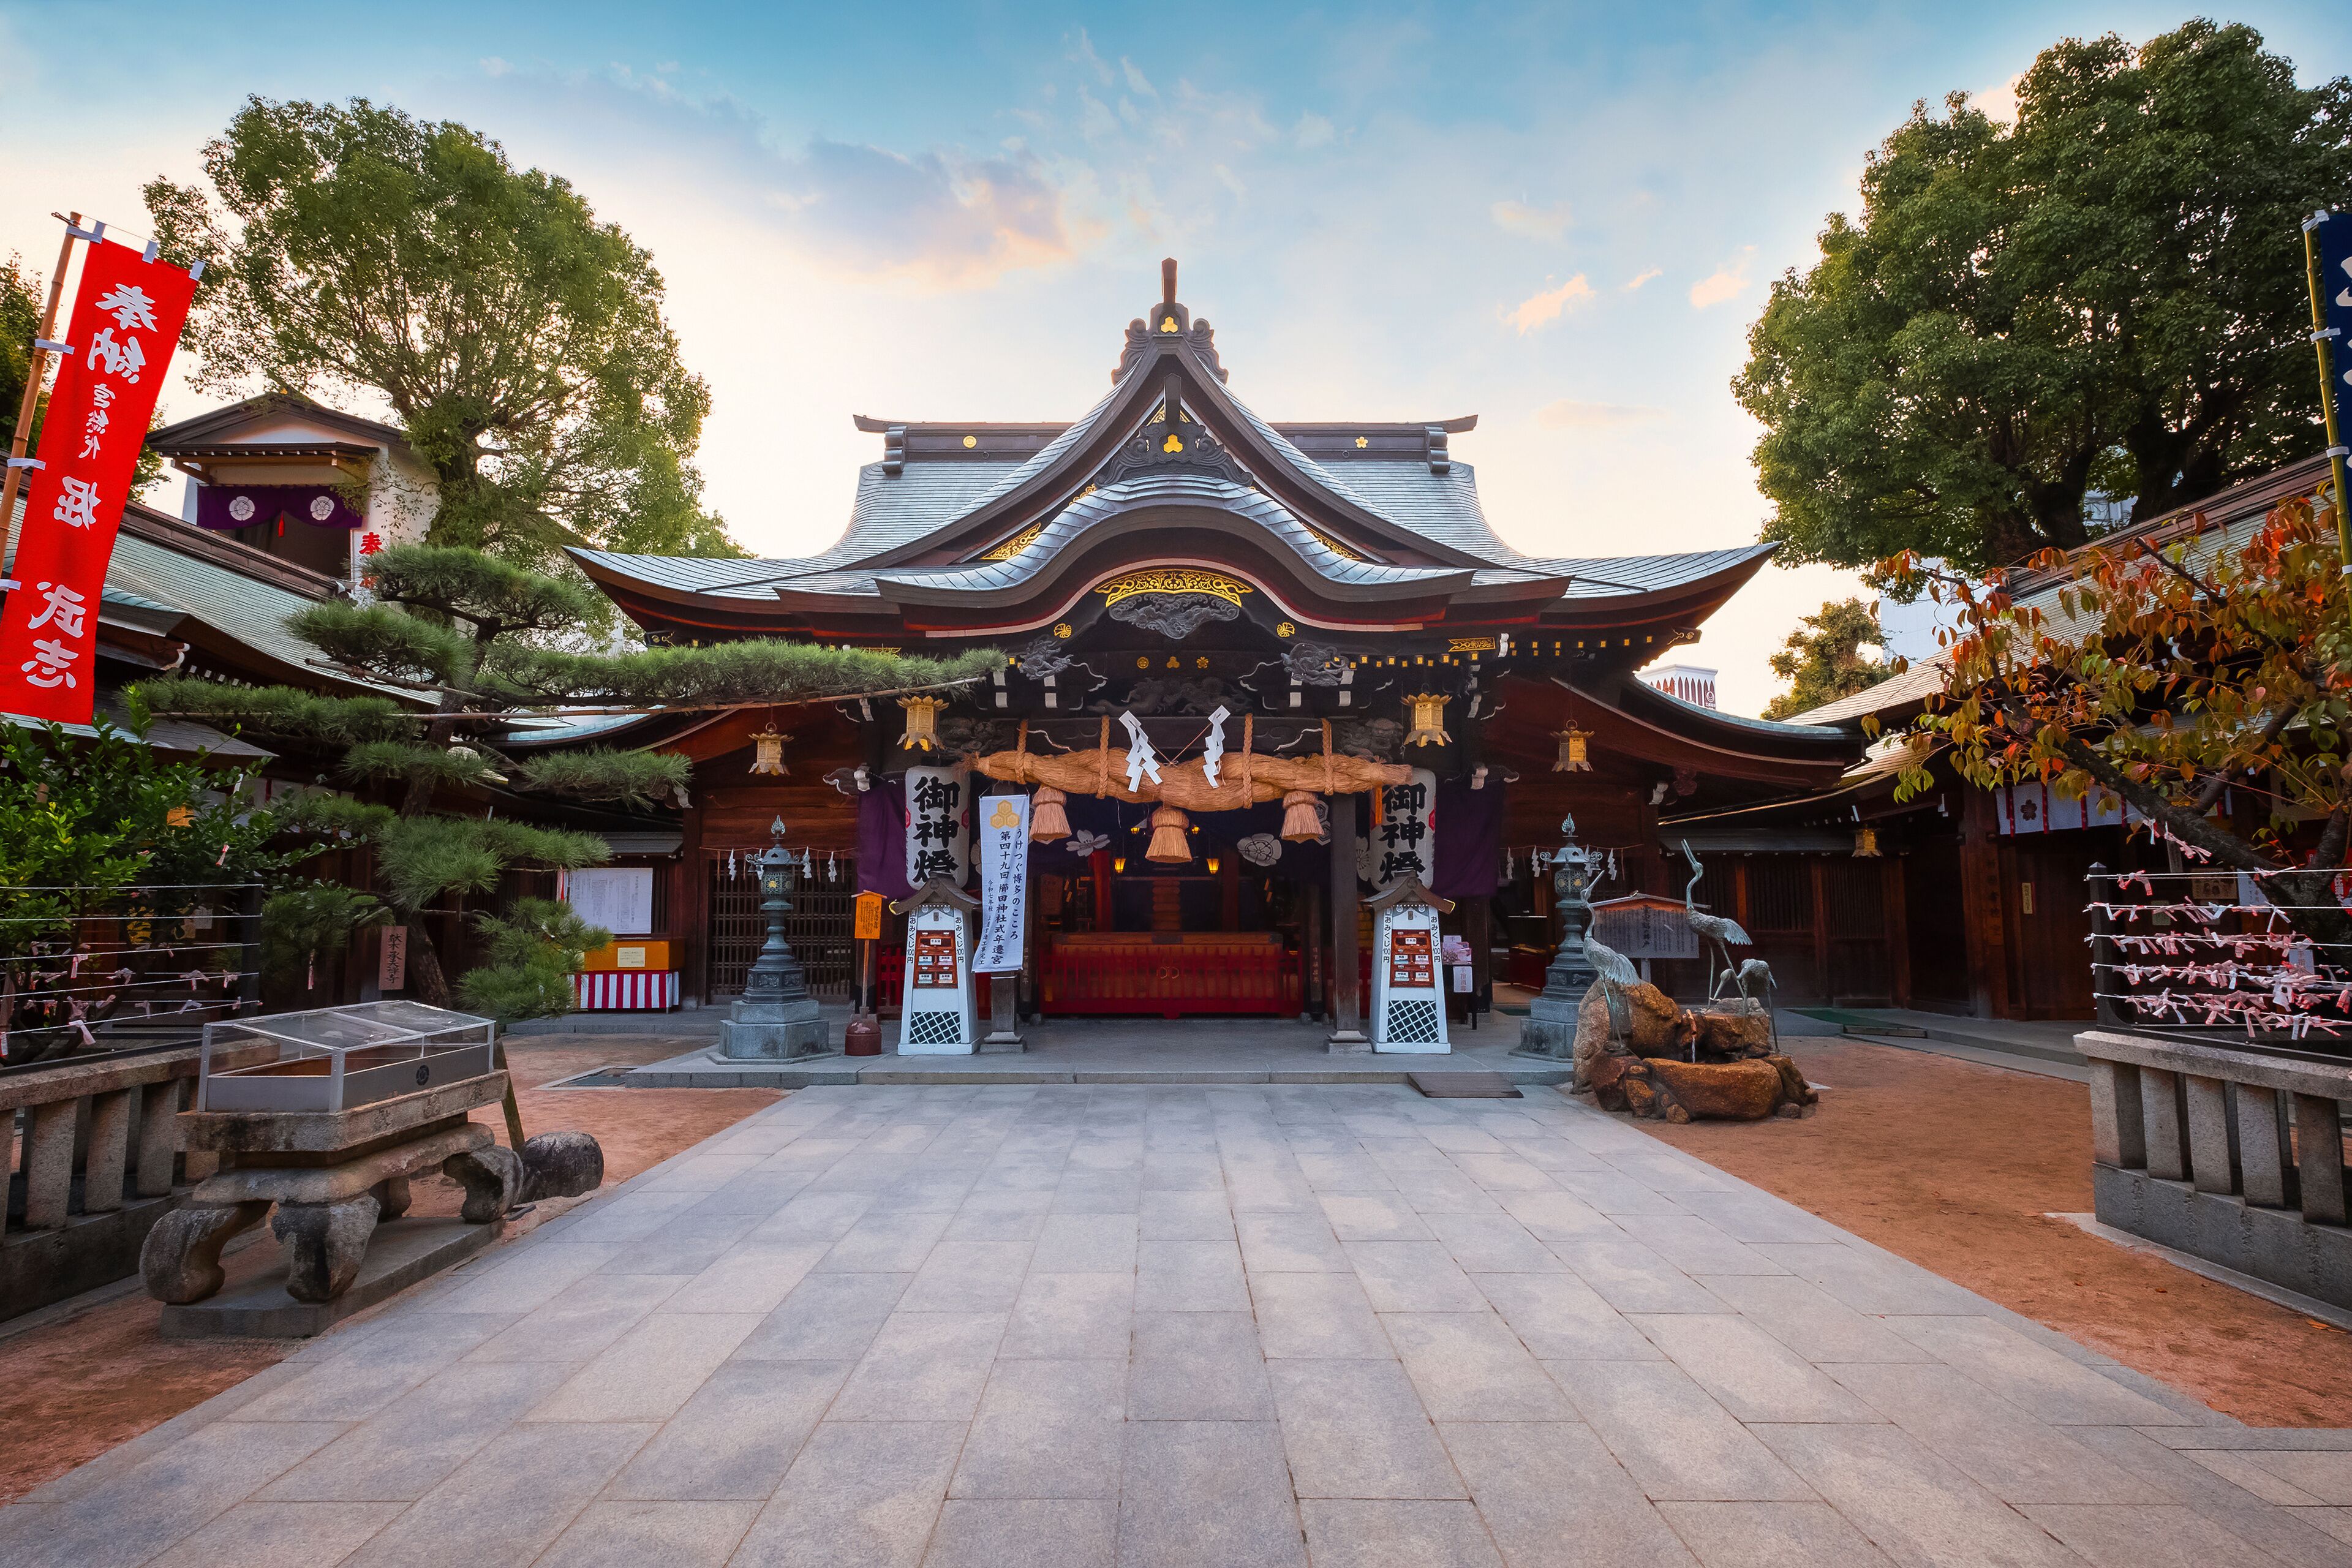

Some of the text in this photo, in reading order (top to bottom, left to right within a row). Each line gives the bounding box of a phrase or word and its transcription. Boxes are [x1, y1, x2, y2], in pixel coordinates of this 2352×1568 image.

[999, 831, 1011, 880] 第四十九回
[1011, 829, 1023, 940] うけつぐ博多のこころ
[955, 917, 965, 963] おみくじ100円
[1431, 916, 1441, 963] おみくじ100円
